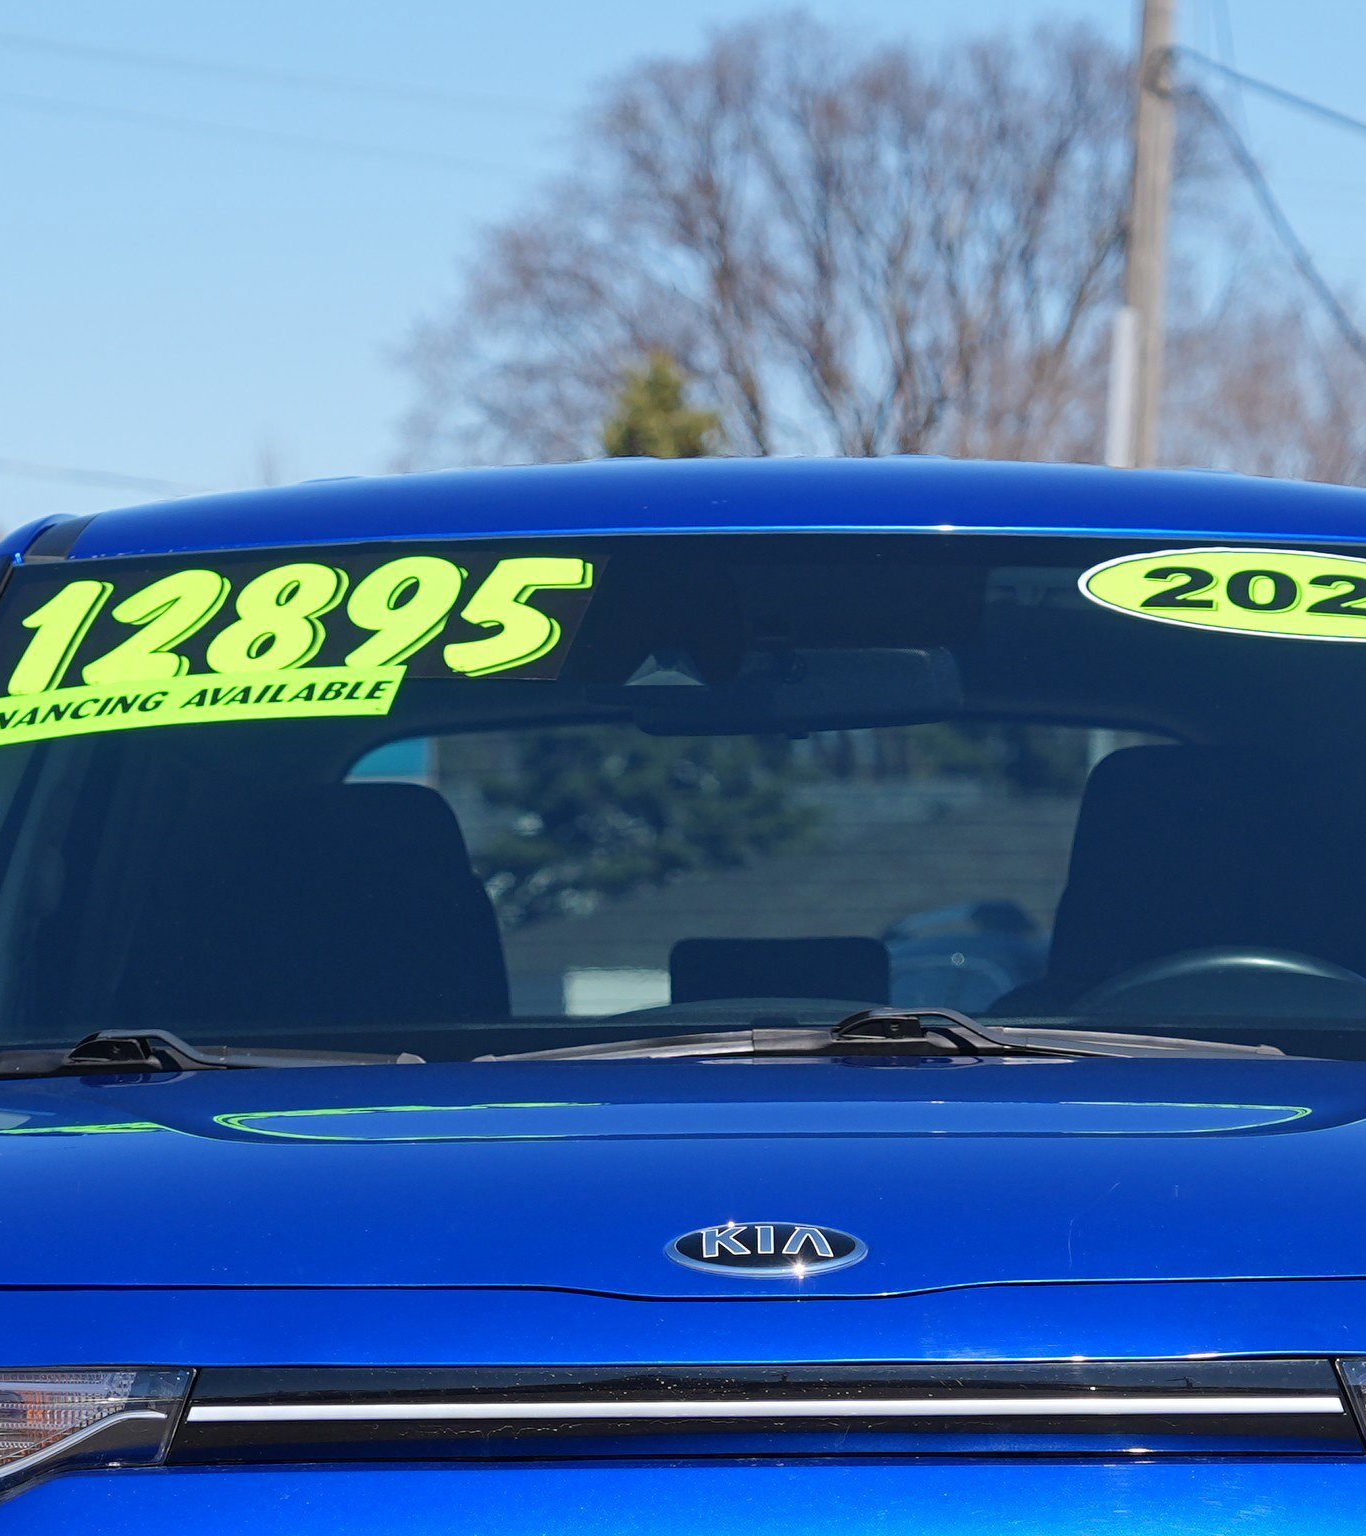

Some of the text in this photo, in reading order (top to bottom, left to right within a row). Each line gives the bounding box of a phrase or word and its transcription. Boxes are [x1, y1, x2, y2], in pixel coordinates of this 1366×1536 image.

[8, 556, 593, 697] 12895
[181, 679, 394, 710] AVAILABLE
[701, 1225, 834, 1258] KIA
